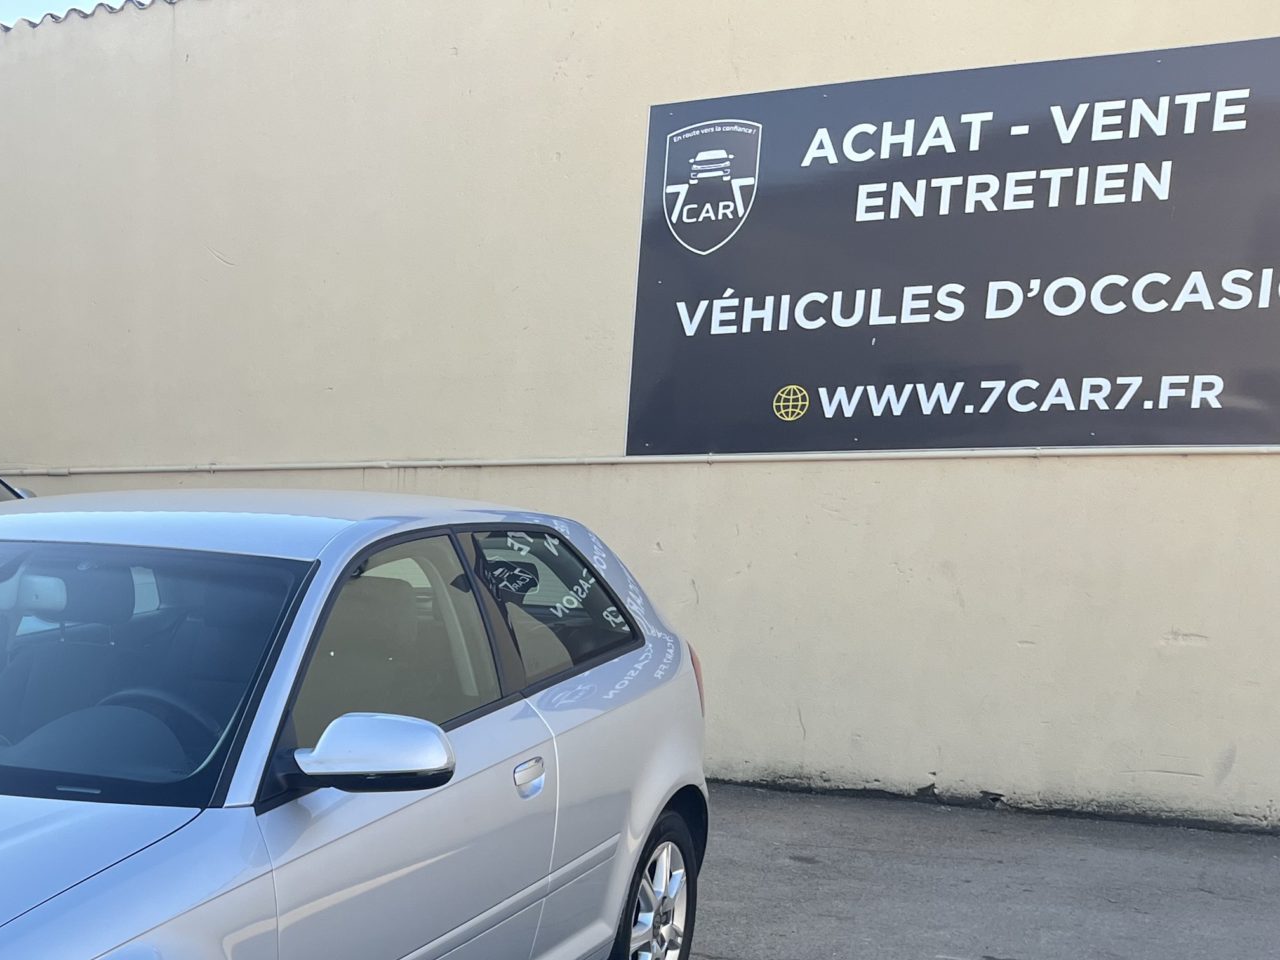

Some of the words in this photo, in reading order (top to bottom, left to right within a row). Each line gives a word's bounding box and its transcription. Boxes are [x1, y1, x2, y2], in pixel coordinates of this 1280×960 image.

[682, 130, 700, 139] route
[722, 125, 753, 134] confiance
[801, 111, 994, 167] ACHAT
[1010, 124, 1030, 136] -
[1050, 88, 1251, 144] VENTE
[855, 160, 1173, 223] ENTRETIEN
[676, 283, 966, 337] VÉHICULES
[985, 268, 1280, 320] D'OCCASI
[818, 374, 1225, 419] WWW.7CAR7.FR
